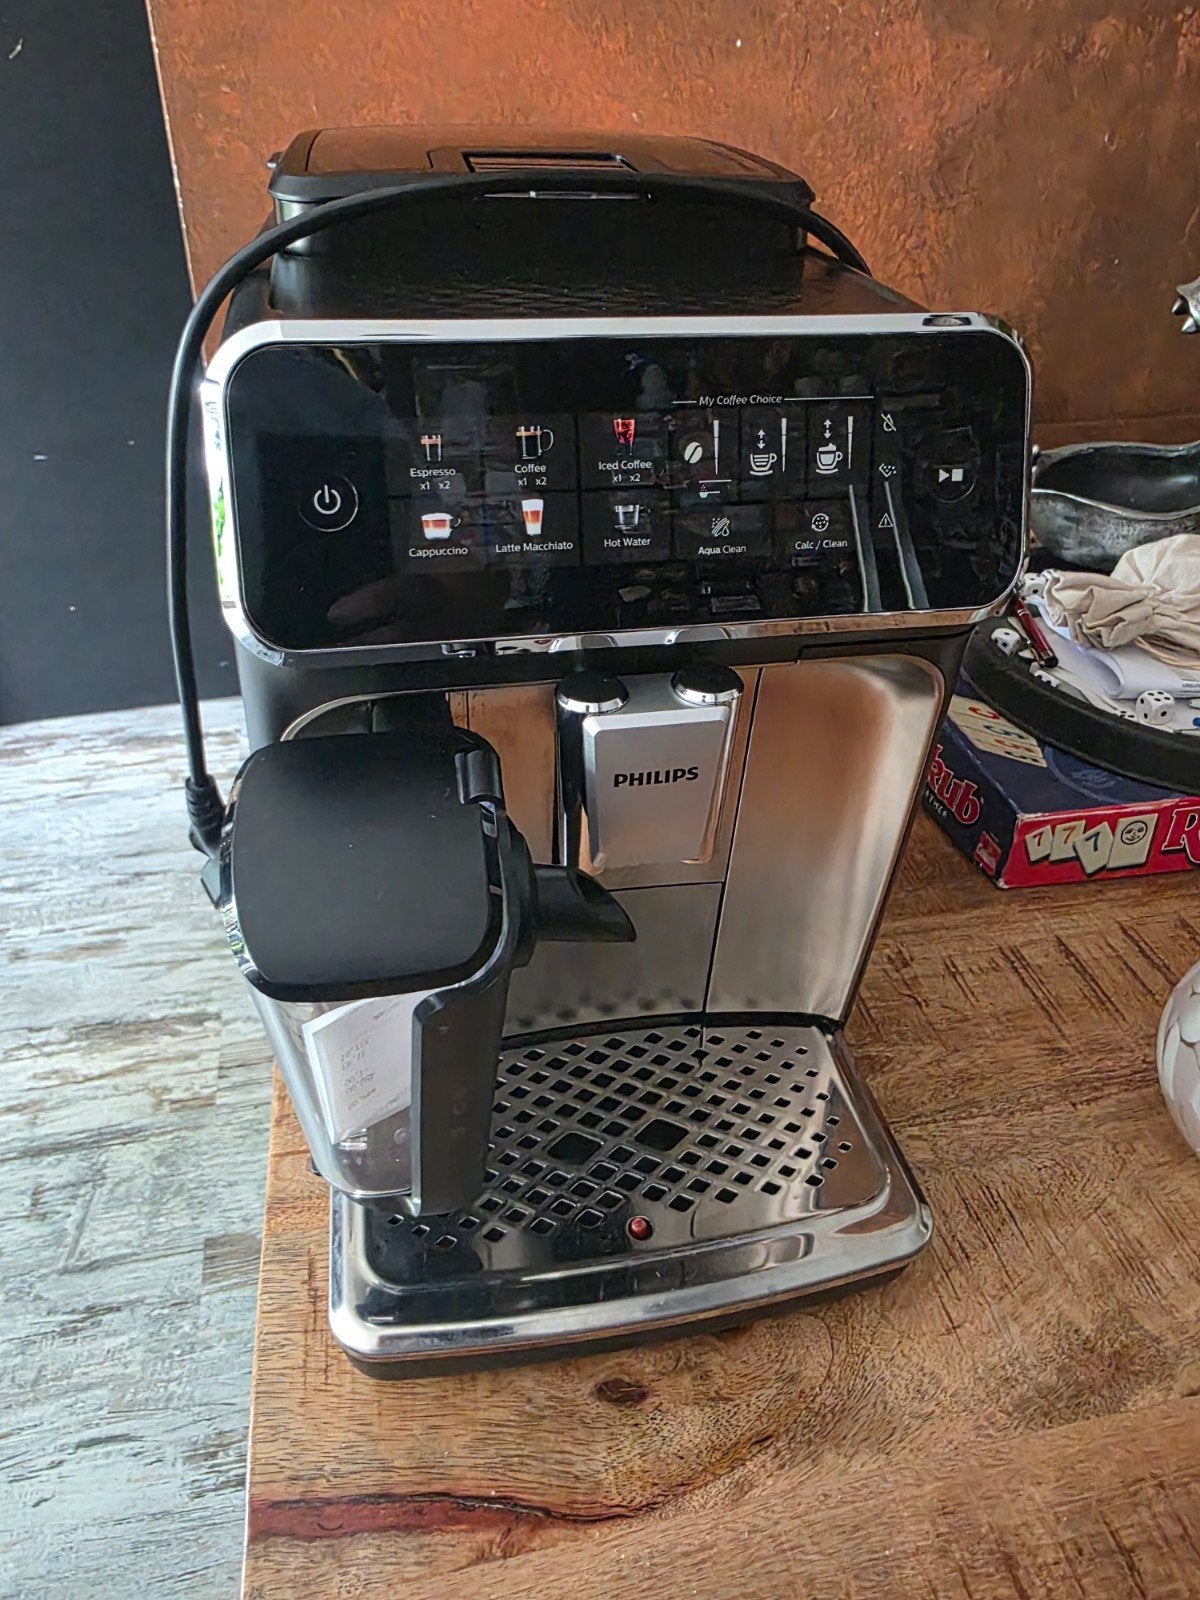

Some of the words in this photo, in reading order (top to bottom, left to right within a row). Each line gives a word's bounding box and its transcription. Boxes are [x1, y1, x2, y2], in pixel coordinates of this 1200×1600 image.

[699, 396, 715, 407] My
[716, 394, 747, 406] Coffee
[749, 394, 782, 404] Choice
[514, 463, 547, 474] Coffee
[598, 460, 619, 471] Iced
[620, 459, 652, 470] Coffee
[410, 467, 456, 479] Espresso
[612, 473, 622, 483] x1
[629, 473, 641, 482] x2
[420, 481, 430, 490] x1
[438, 480, 451, 490] x2
[517, 477, 528, 486] x1
[535, 476, 548, 486] x2
[495, 543, 521, 553] Latte
[523, 540, 573, 552] Macchiato
[603, 538, 621, 548] Hot
[622, 536, 651, 547] Water
[794, 540, 814, 550] Calc
[822, 538, 848, 549] Clean
[408, 546, 468, 558] Cappuccino
[697, 546, 721, 556] Aqua
[722, 544, 747, 554] Clean
[613, 766, 699, 788] PHILIPS
